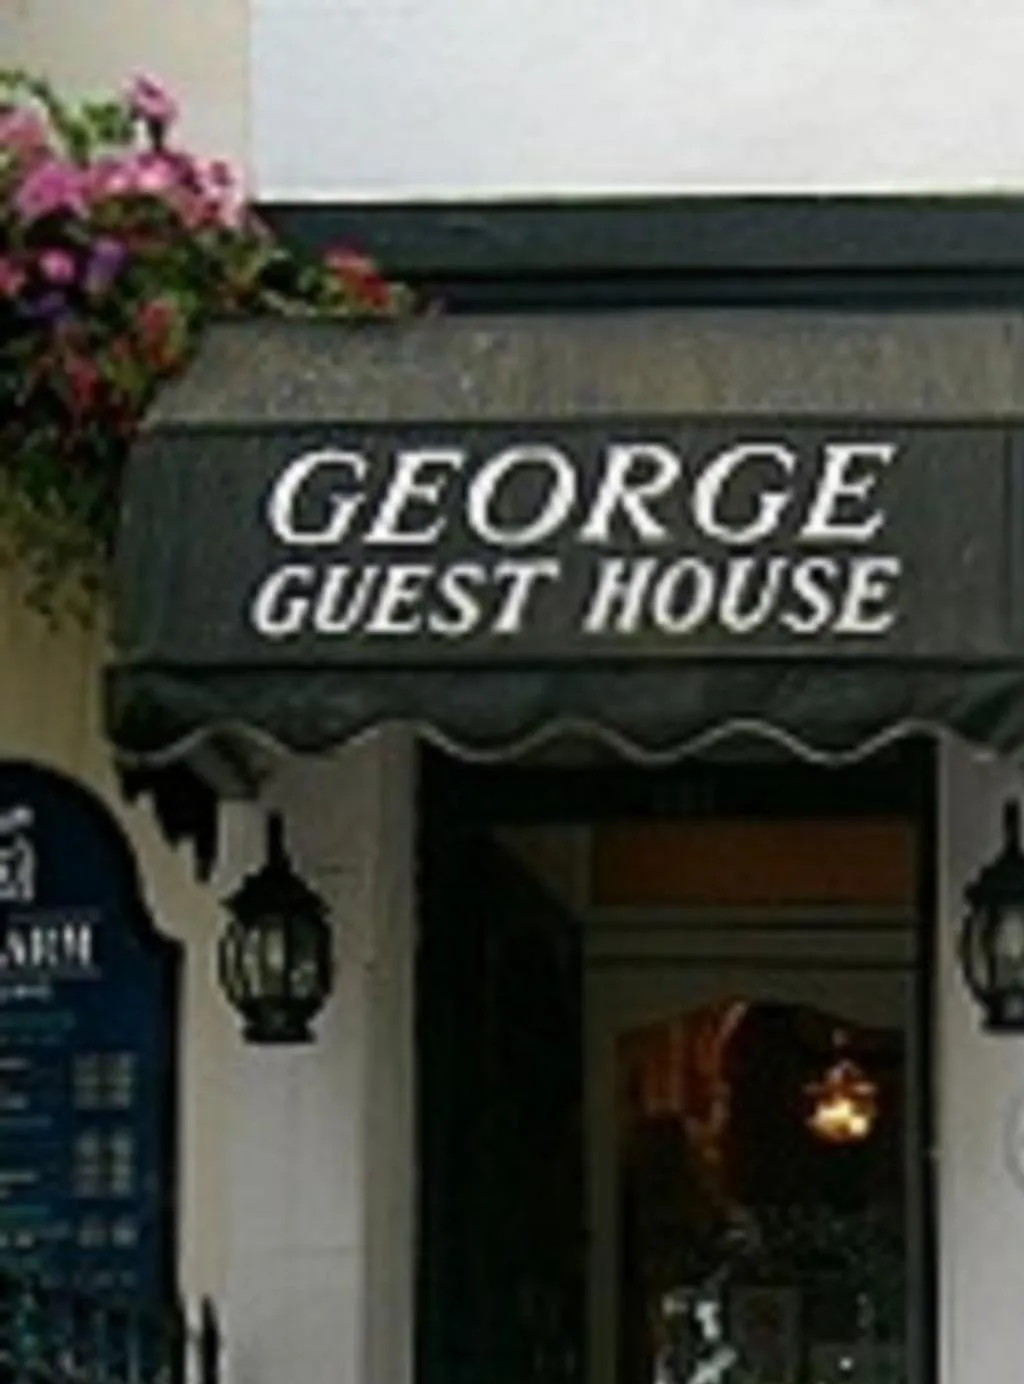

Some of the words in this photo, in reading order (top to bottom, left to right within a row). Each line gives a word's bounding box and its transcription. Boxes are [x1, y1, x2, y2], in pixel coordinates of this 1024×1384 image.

[267, 444, 897, 544] GEORGE
[252, 558, 561, 636] GUEST
[583, 556, 900, 636] HOUSE
